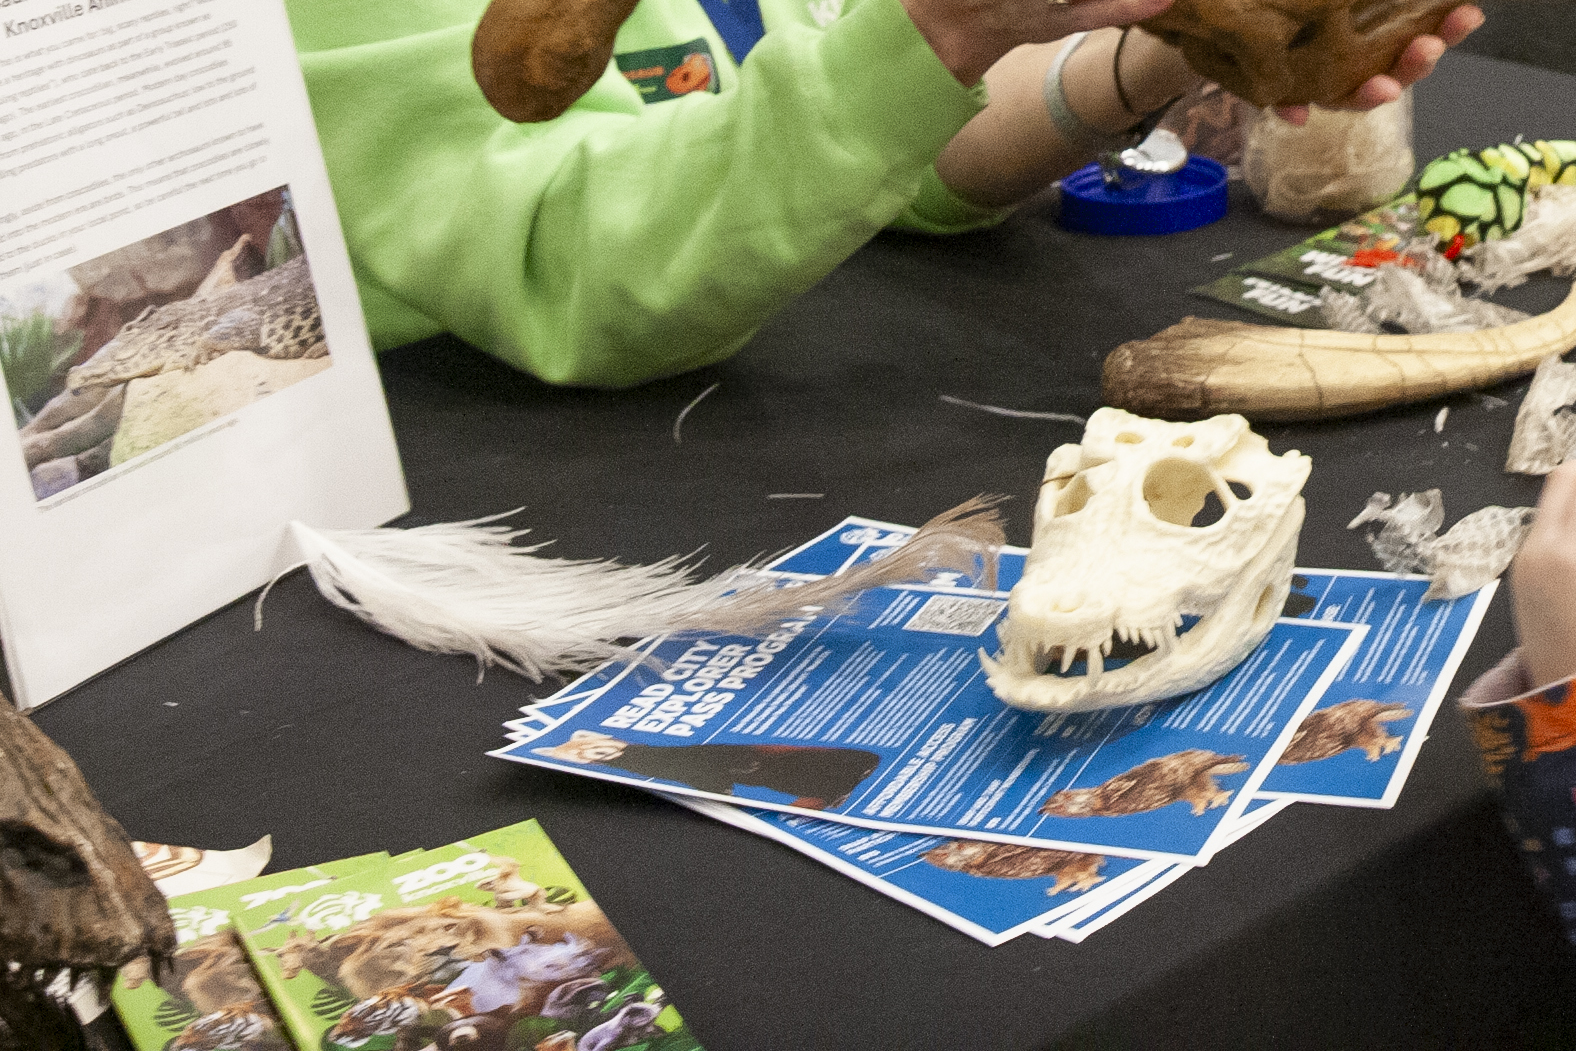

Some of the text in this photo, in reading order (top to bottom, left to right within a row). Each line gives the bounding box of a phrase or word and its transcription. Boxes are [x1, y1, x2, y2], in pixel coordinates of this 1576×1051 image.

[4, 3, 84, 38] Knoxville
[600, 640, 721, 729] READ CITY
[631, 643, 753, 734] EXPLORER
[662, 691, 736, 738] PASS
[391, 852, 491, 894] ZOO
